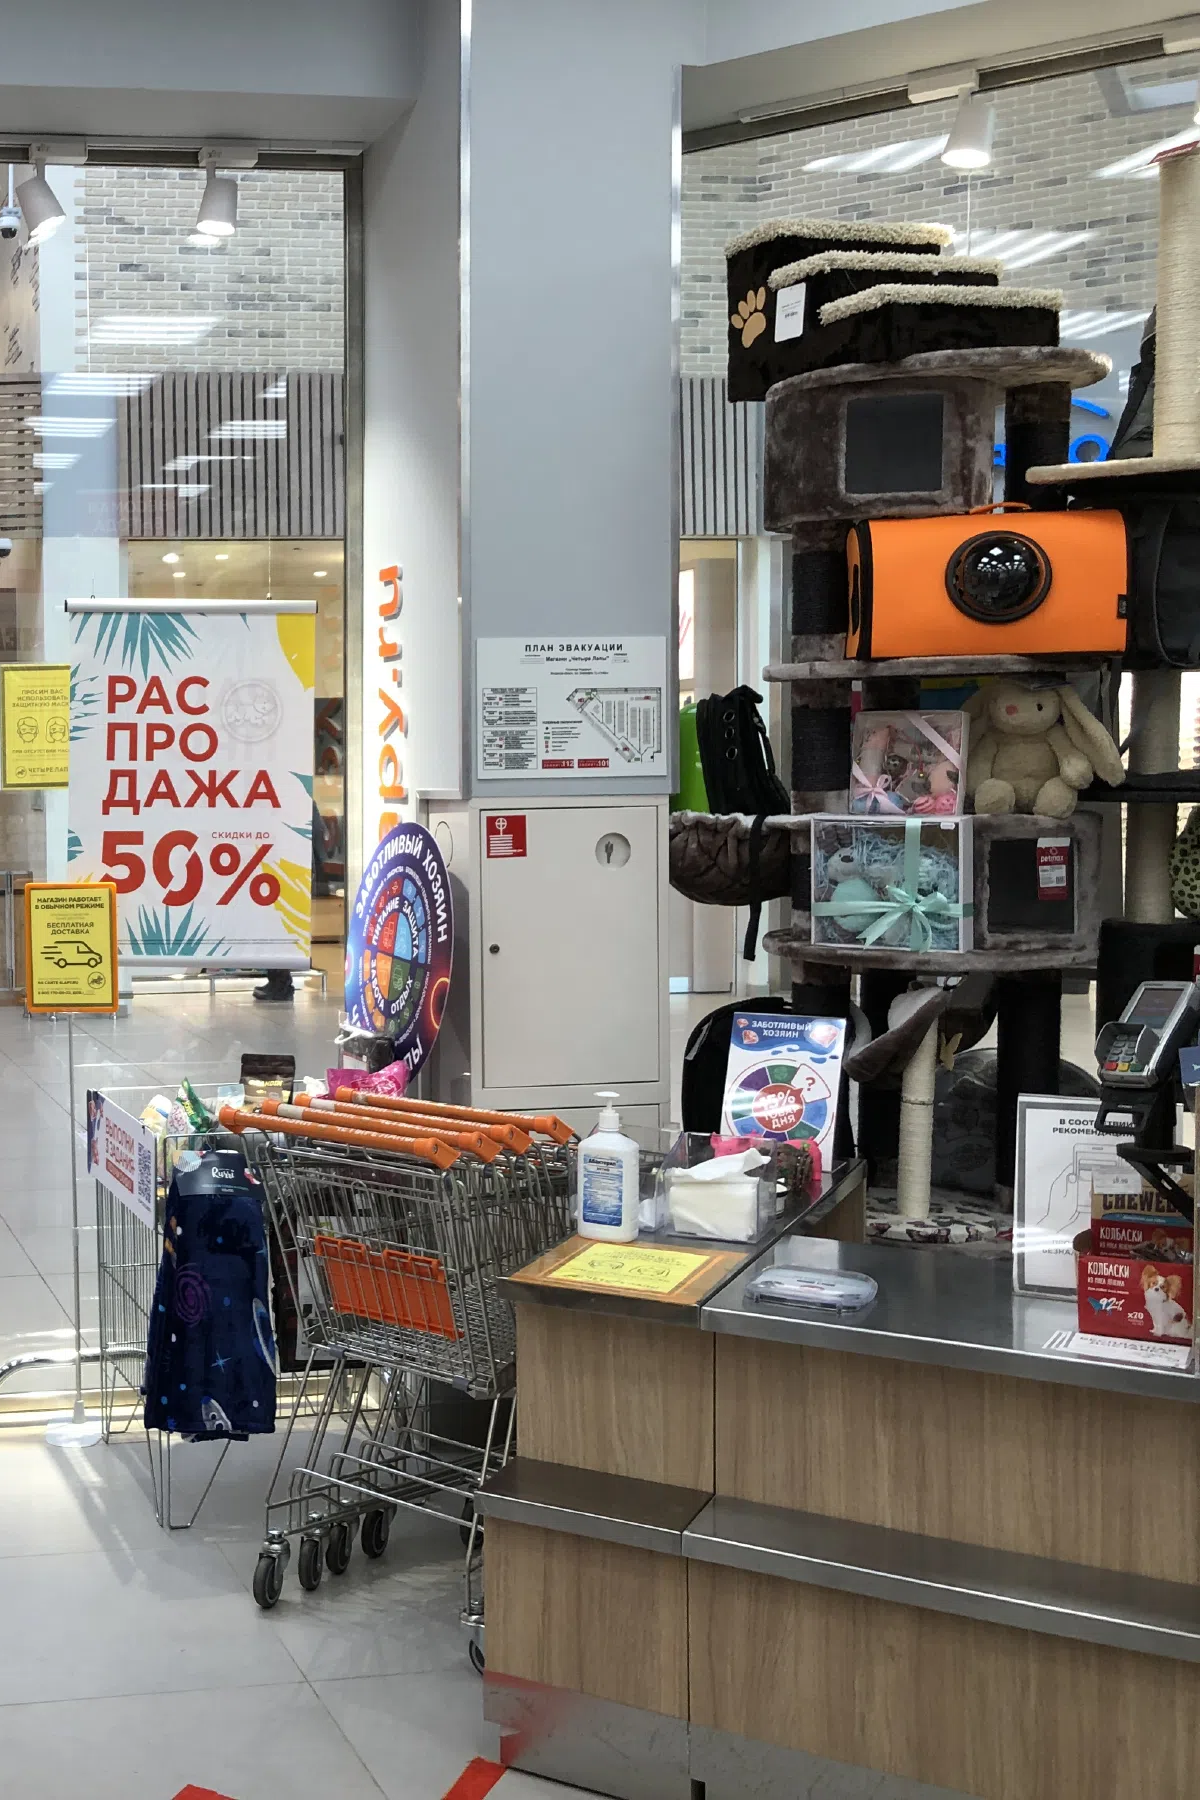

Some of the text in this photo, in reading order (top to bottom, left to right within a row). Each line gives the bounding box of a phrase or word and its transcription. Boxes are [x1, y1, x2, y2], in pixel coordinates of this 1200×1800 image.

[525, 643, 623, 652] ПЛАН ЭВАКУАЦИИ
[107, 674, 210, 716] РАС
[105, 722, 218, 763] ПРО
[101, 769, 282, 816] ДАЖА
[211, 831, 270, 841] СКИДКИ ДО
[1040, 855, 1064, 863] petmax
[100, 829, 281, 907] 50%
[356, 833, 448, 943] ЗАБОТЛИВЫЙ ХОЗЯИН
[371, 896, 400, 946] ПИТАНИЕ
[402, 900, 419, 958] ЗАЩИТА
[371, 958, 385, 1012] ЗАБОТА
[390, 975, 413, 1015] ОТДЫХ
[751, 1020, 812, 1031] ЗАБОТЛИВЫЙ
[762, 1029, 799, 1038] ХОЗЯИН
[771, 1116, 796, 1129] ДНЯ
[1099, 1226, 1143, 1242] КОЛБАСКИ
[1087, 1261, 1130, 1278] КОЛБАСКИ
[1099, 1297, 1125, 1312] 92%
[1127, 1312, 1144, 1320] x20
